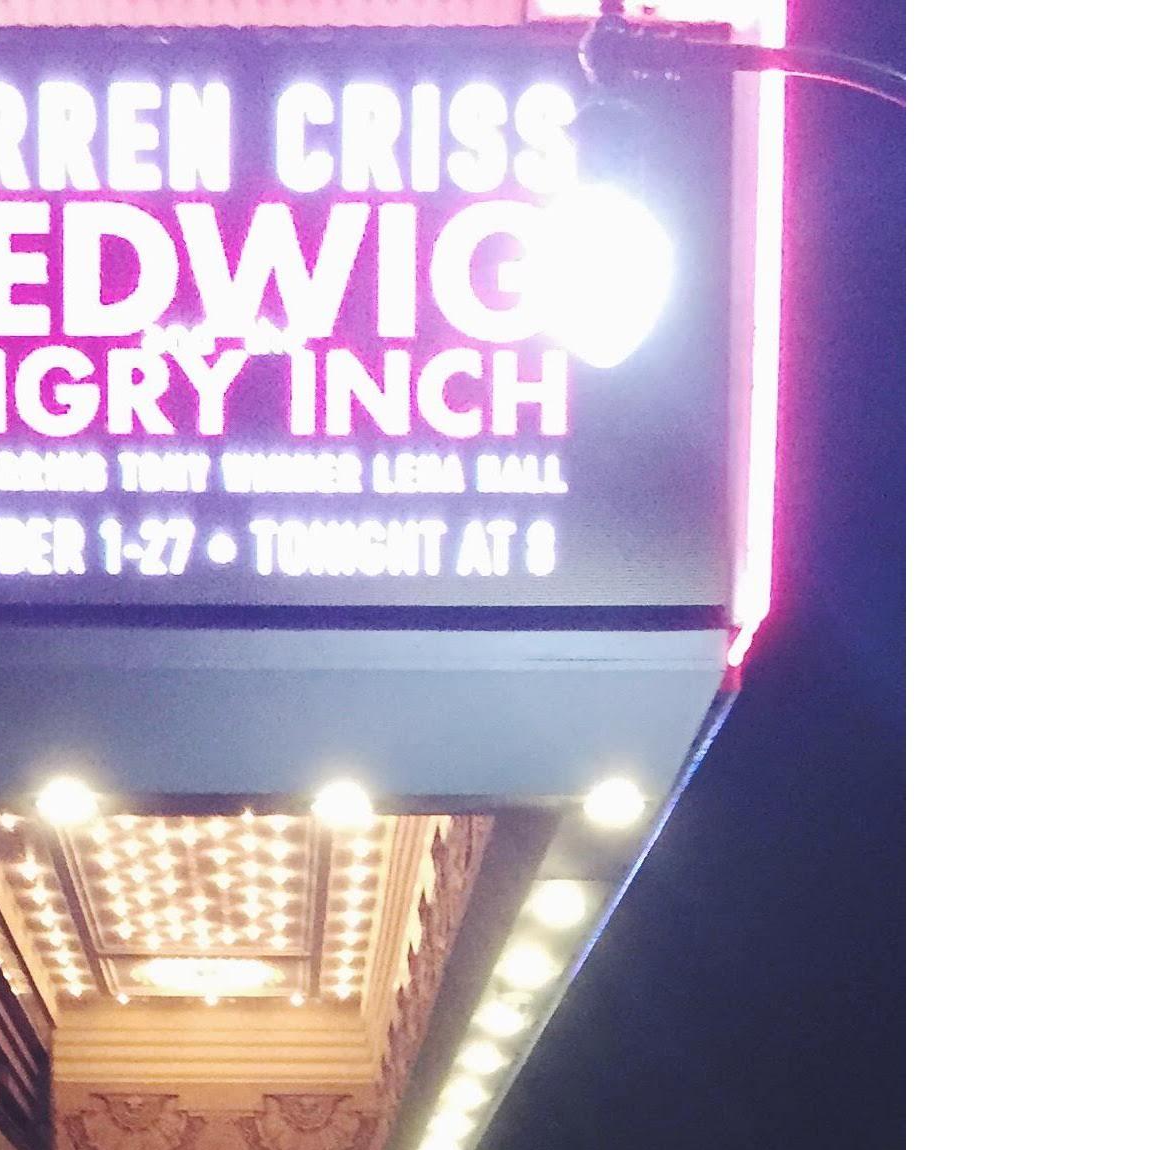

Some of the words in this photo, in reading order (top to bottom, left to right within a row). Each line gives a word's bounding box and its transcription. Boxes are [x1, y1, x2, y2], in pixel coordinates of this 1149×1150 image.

[276, 81, 580, 194] CRISS
[290, 346, 569, 438] INCH
[99, 518, 195, 576] 1-27
[249, 519, 448, 577] TONIGHT
[456, 519, 517, 577] AT
